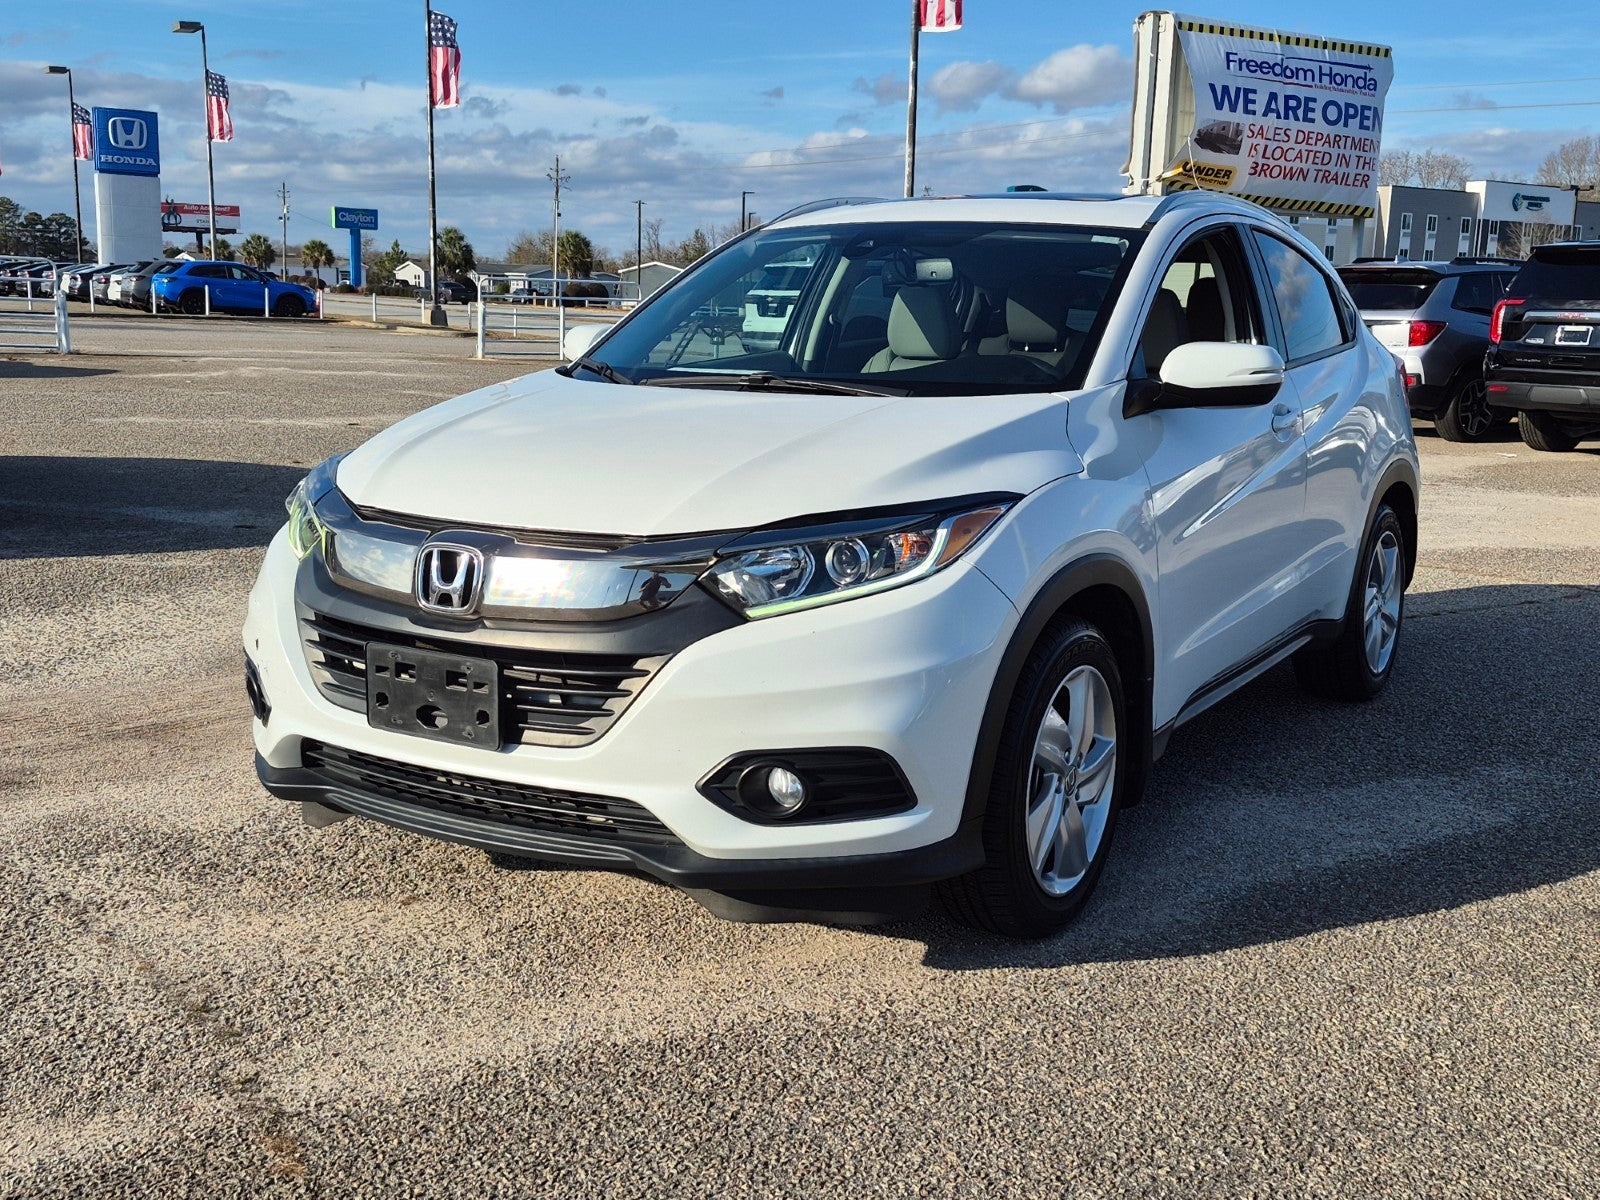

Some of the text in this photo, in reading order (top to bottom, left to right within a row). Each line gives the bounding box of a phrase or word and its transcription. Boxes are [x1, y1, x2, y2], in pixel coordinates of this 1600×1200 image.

[1225, 52, 1377, 91] Freedom Honda
[1208, 83, 1383, 132] WE ARE OPEN
[1246, 123, 1292, 143] SALES
[100, 154, 157, 166] HONDA
[1247, 142, 1376, 172] IS LOCATED IN THE
[1181, 161, 1233, 180] UNDER
[1313, 168, 1370, 189] TRAILER
[338, 211, 375, 223] Clayton
